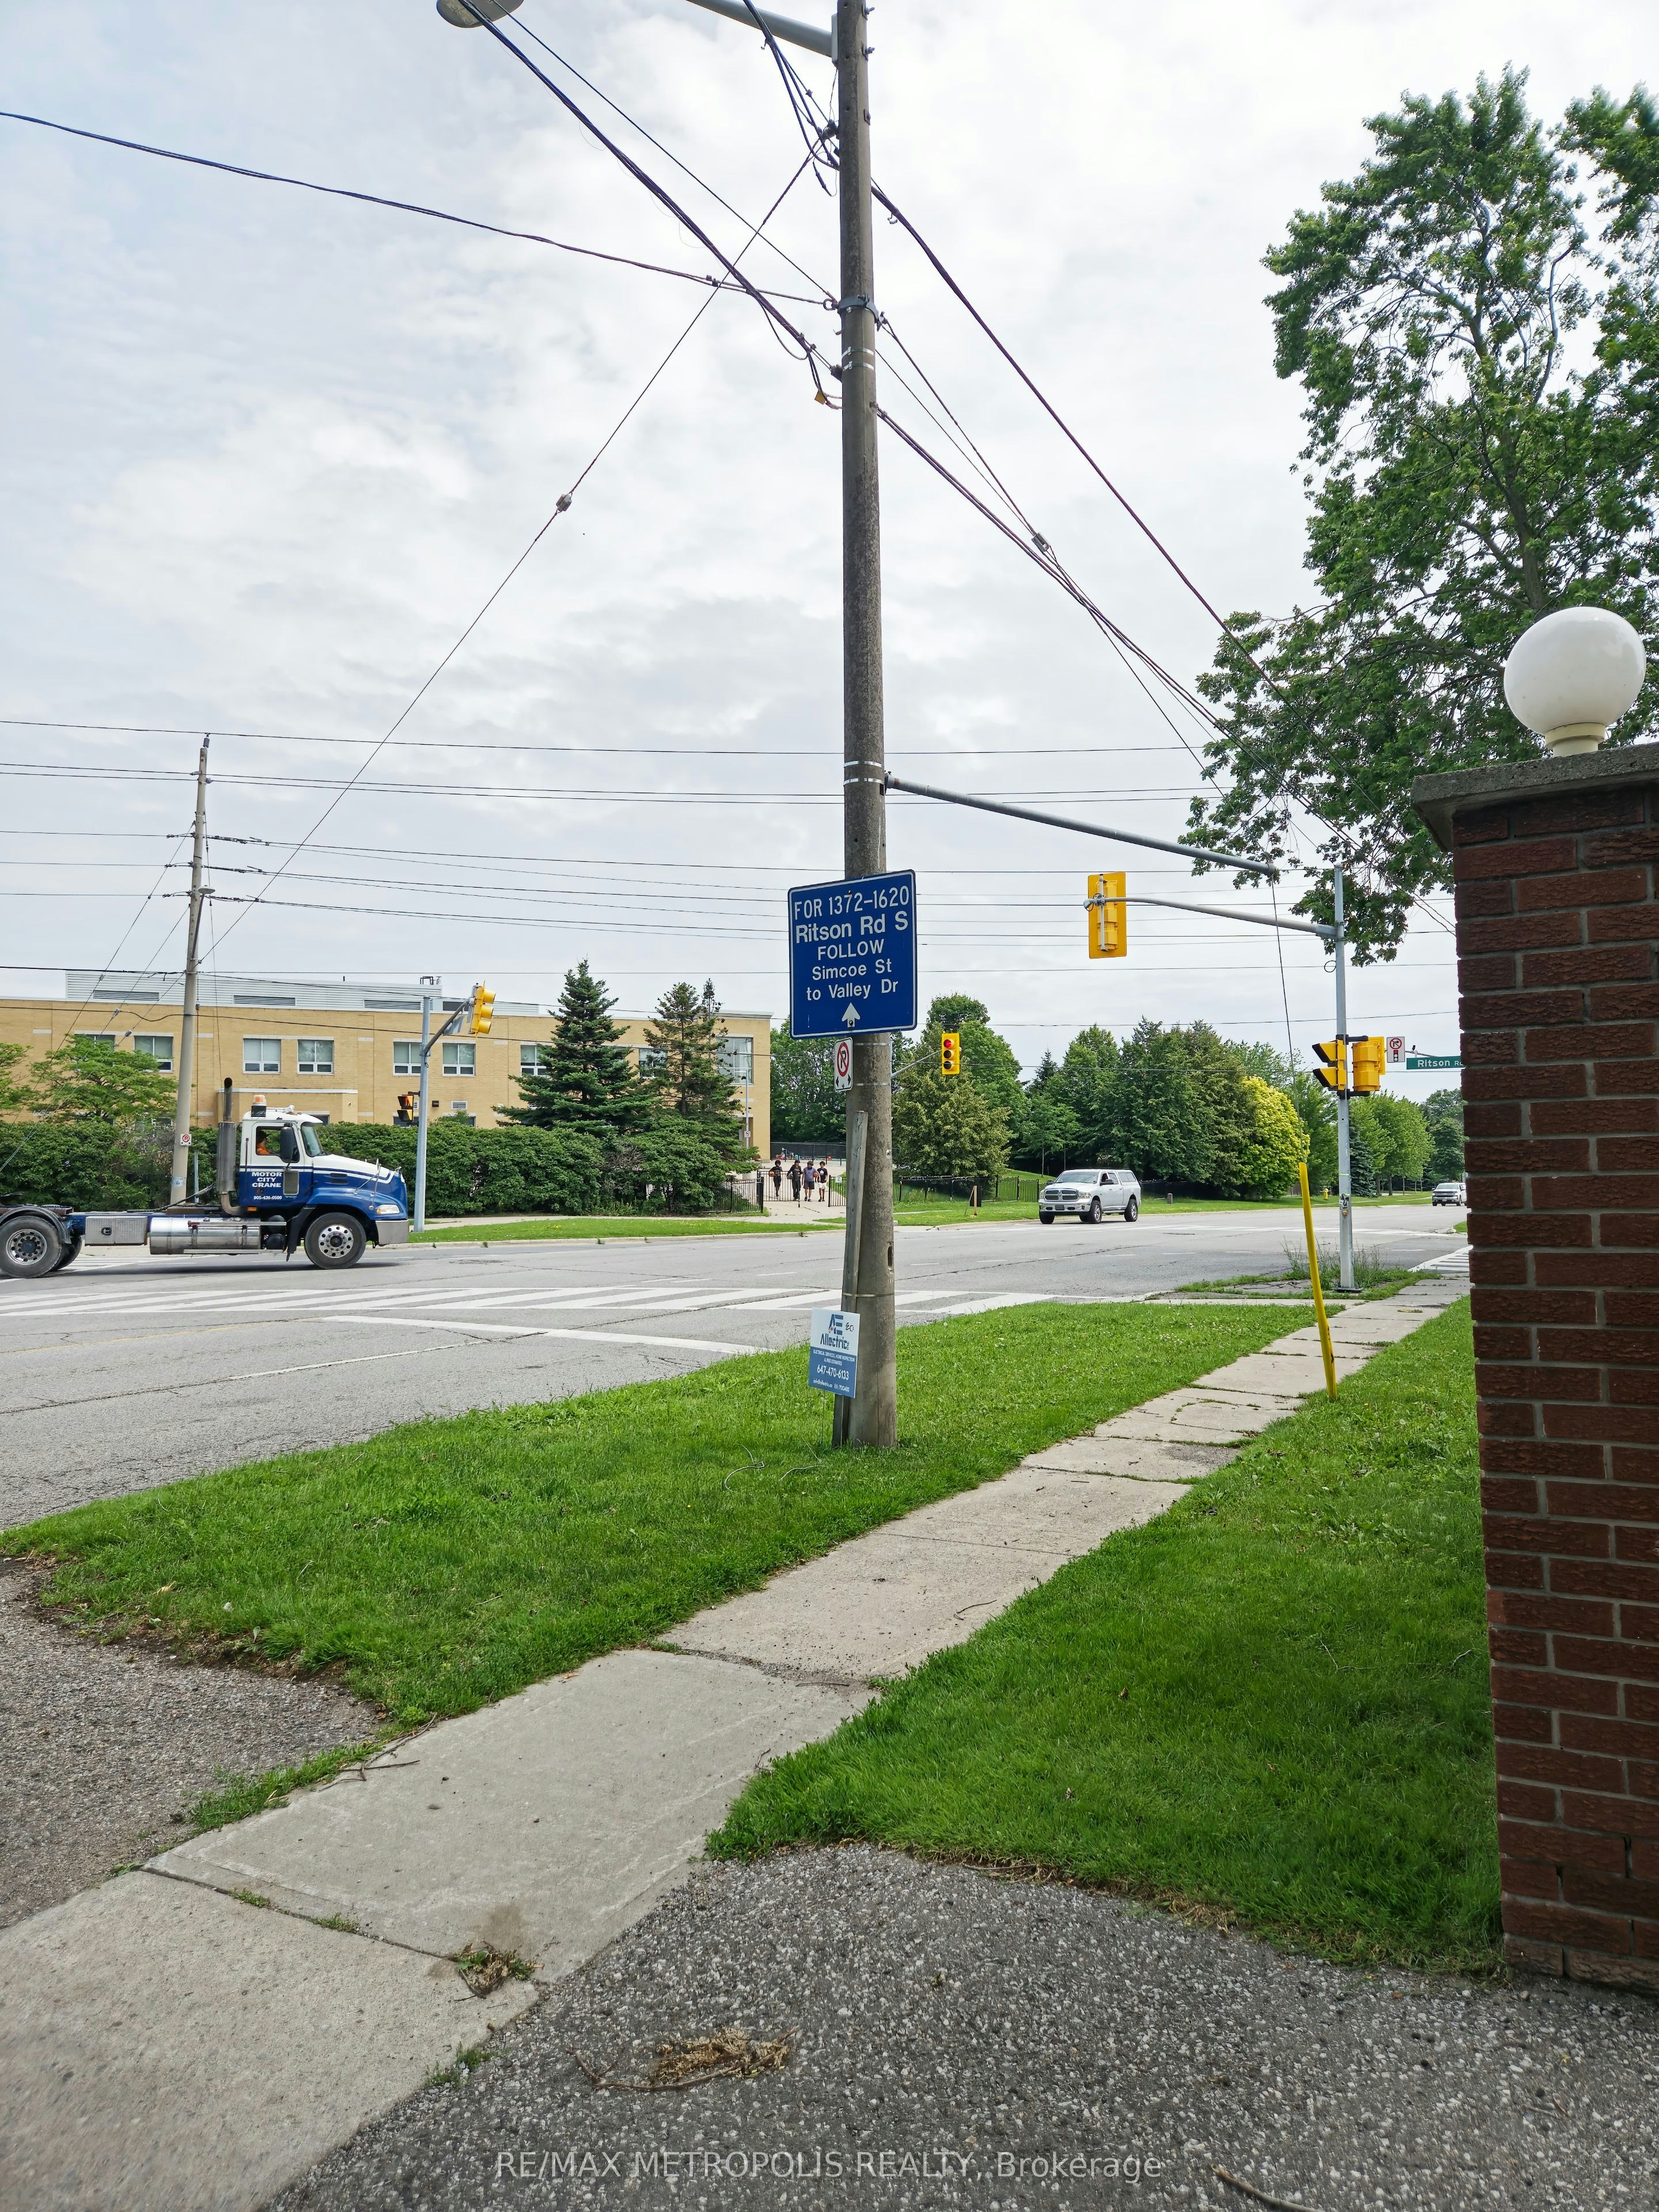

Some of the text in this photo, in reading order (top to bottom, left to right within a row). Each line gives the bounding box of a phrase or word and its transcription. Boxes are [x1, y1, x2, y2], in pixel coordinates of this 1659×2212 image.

[794, 885, 909, 920] FOR 1372-1620
[796, 911, 908, 944] Ritson Rd S
[818, 939, 884, 960] FOLLOW
[812, 959, 892, 980] Simcoe St
[806, 979, 898, 1001] to Valley Dr
[817, 1364, 849, 1380] 647-470-6133
